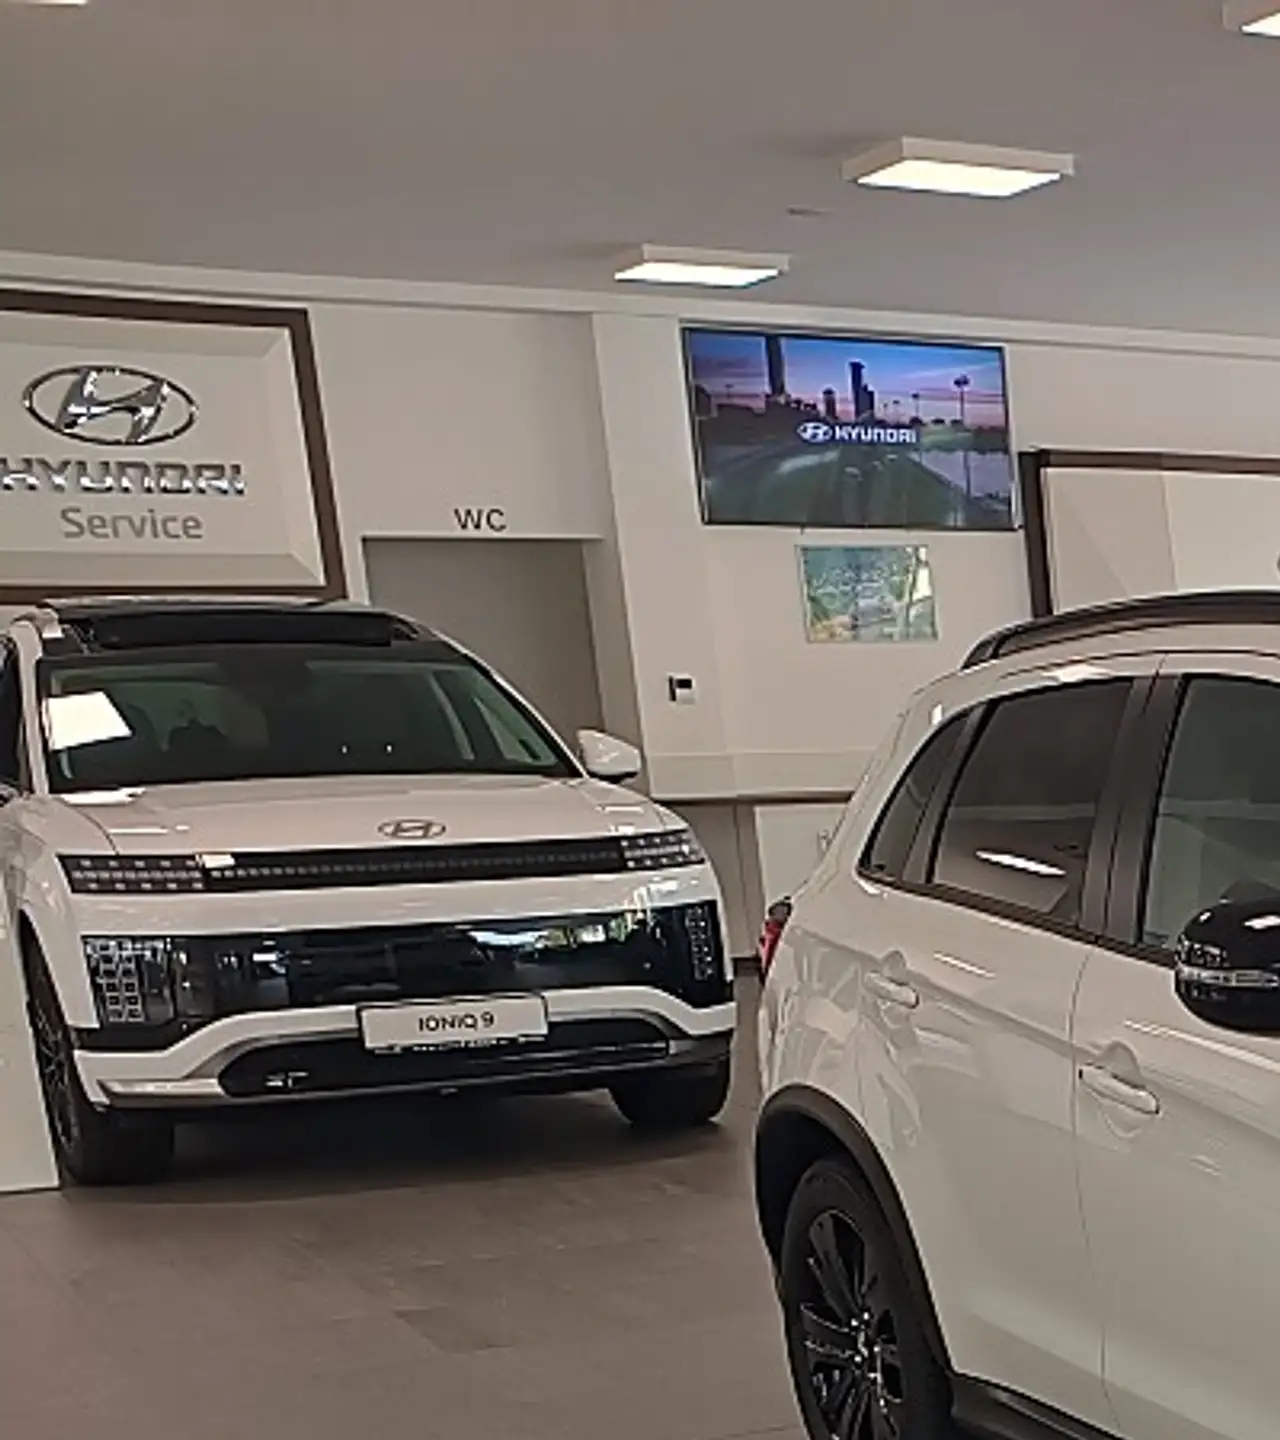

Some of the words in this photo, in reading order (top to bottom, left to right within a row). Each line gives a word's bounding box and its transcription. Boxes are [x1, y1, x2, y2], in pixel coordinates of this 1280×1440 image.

[835, 425, 917, 444] HYUNDAI
[0, 458, 246, 495] HYUNDAI
[60, 506, 204, 539] Service
[454, 508, 507, 532] WC
[418, 1013, 478, 1032] IONIQ
[481, 1010, 495, 1028] 9
